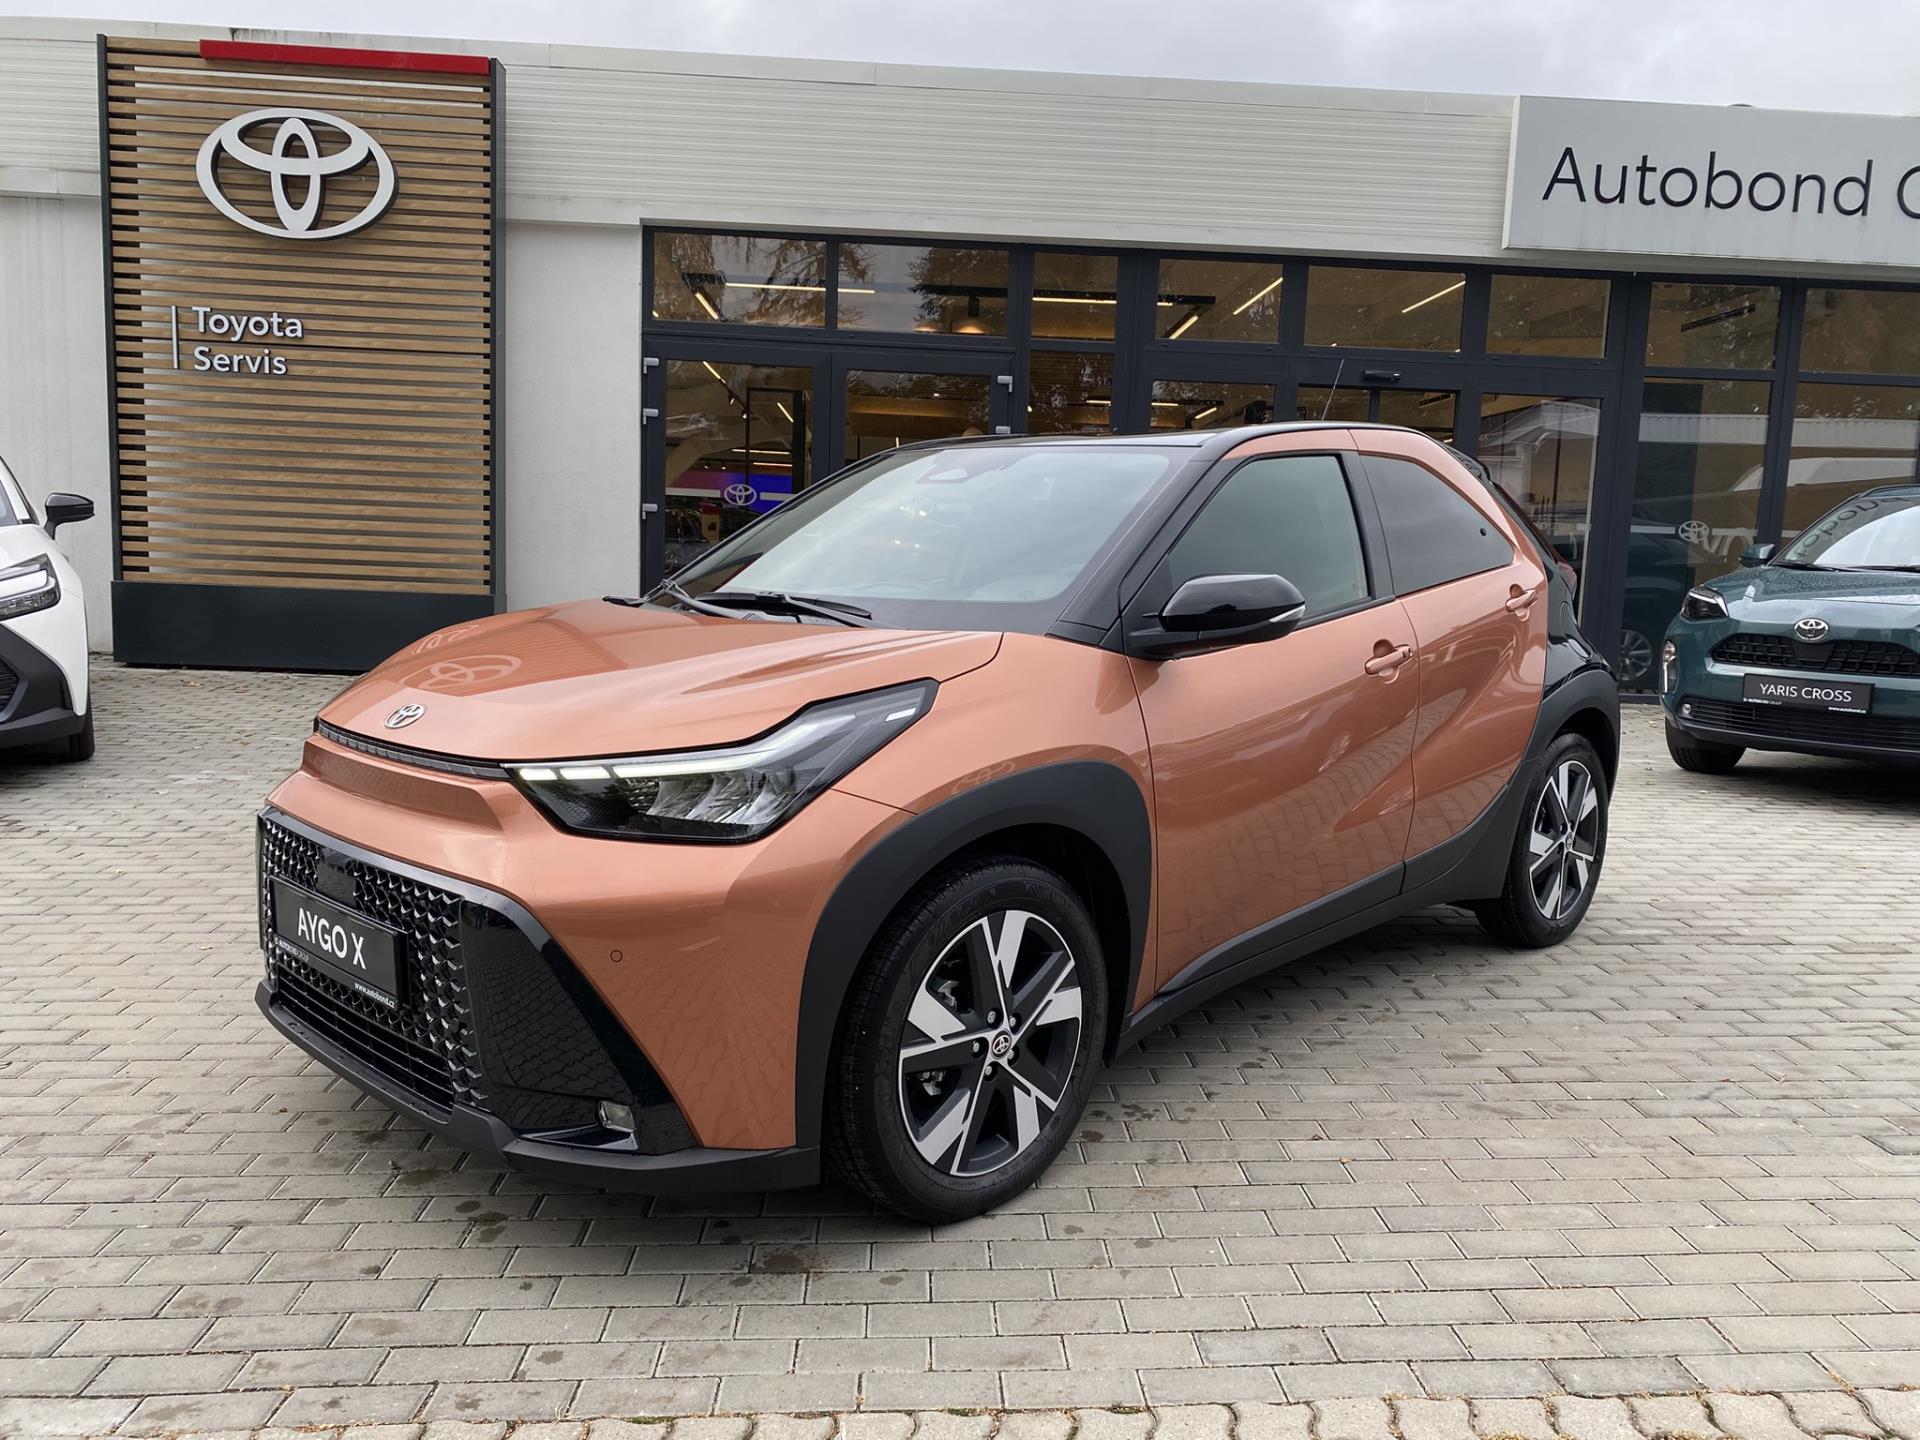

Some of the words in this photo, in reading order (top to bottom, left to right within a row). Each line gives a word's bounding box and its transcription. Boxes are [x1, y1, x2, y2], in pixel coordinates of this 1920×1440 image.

[1542, 146, 1874, 217] Autobond
[191, 306, 304, 342] Toyota
[193, 346, 288, 375] Servis
[1760, 683, 1798, 698] YARIS
[1801, 687, 1852, 703] CROSS
[298, 907, 348, 959] AYGO
[351, 932, 367, 970] X
